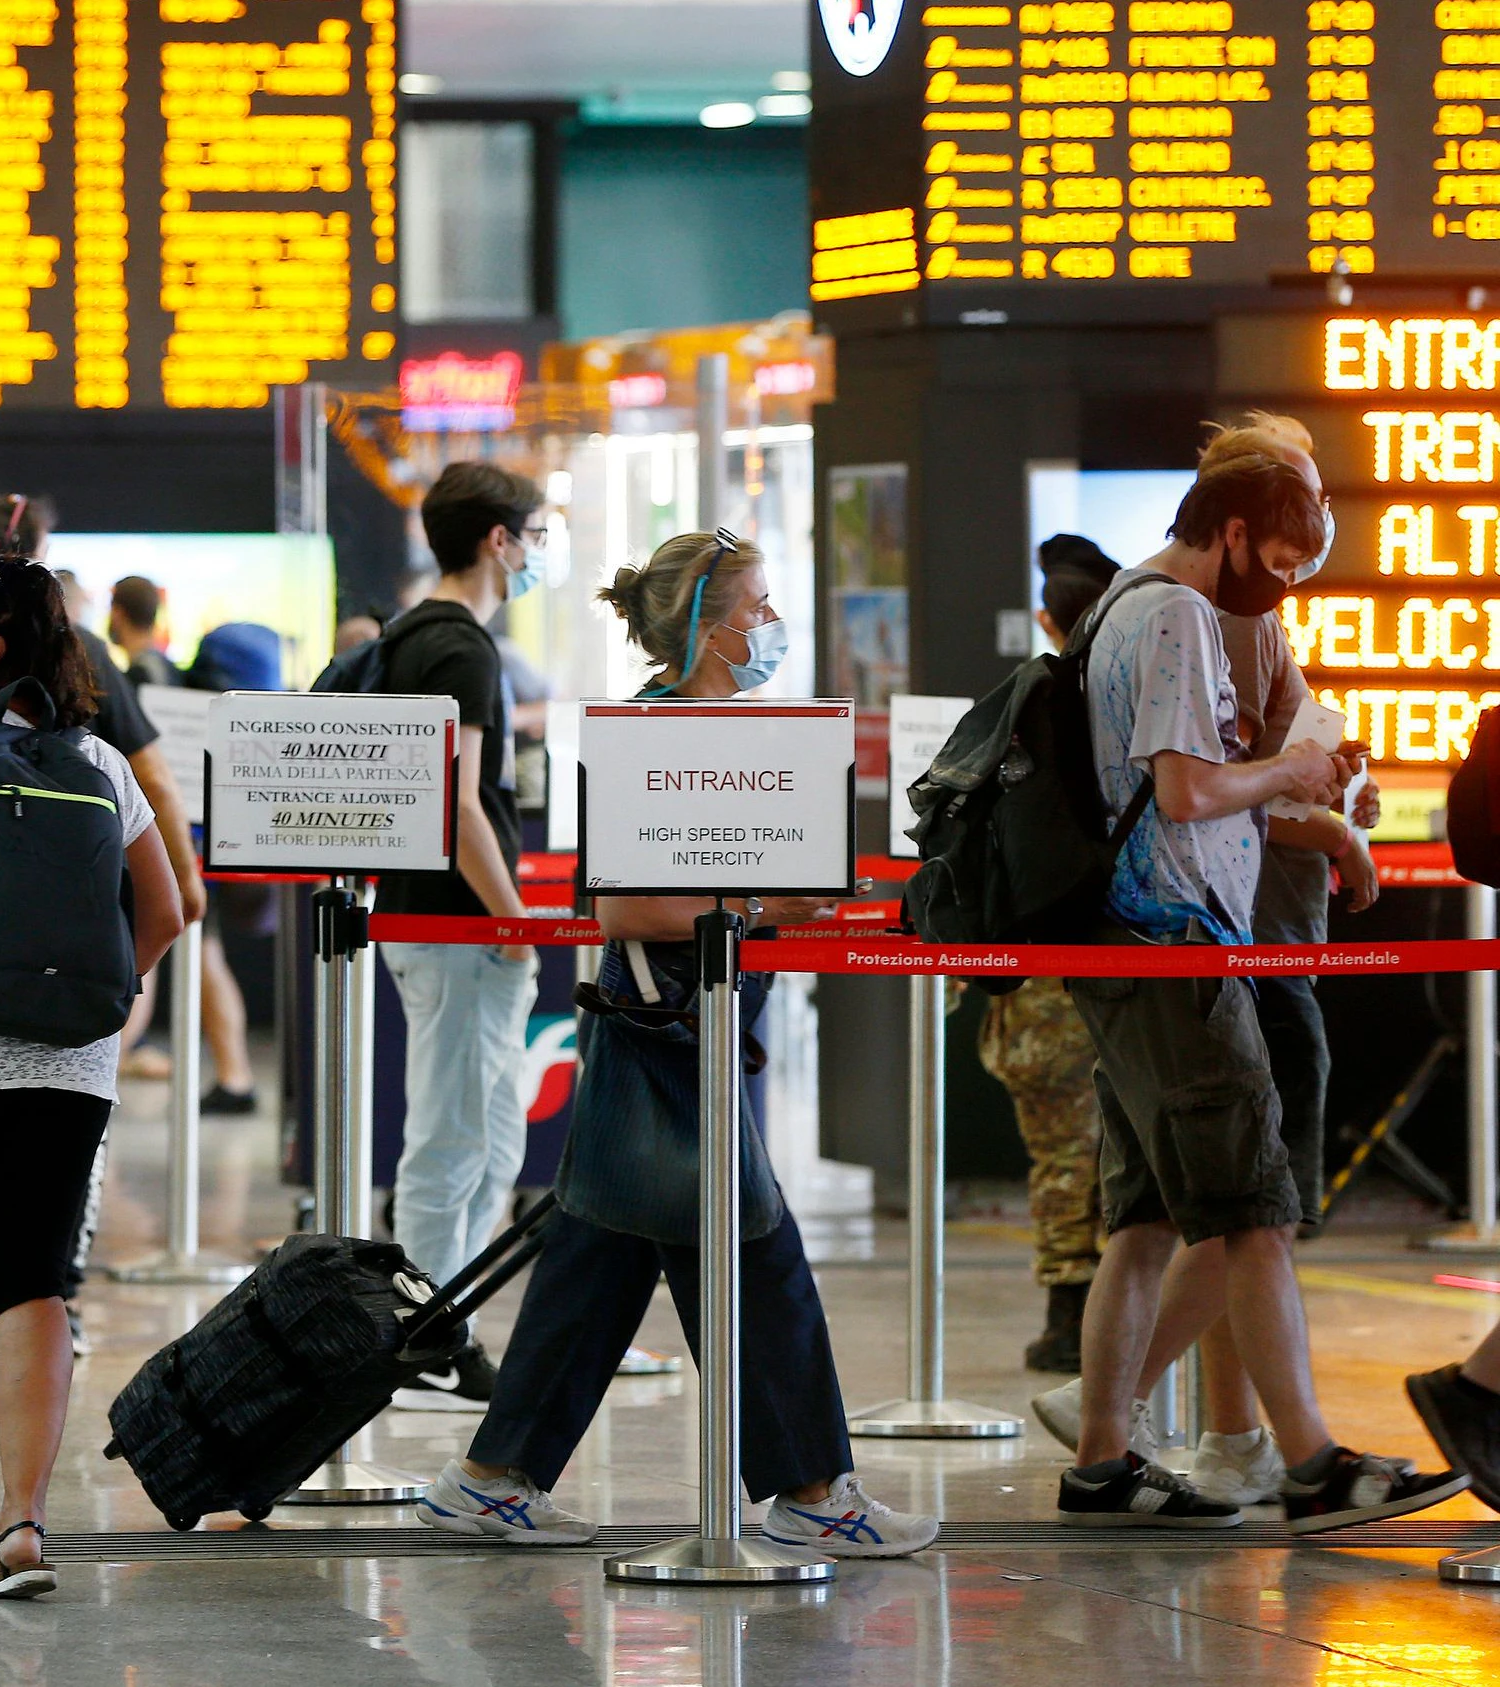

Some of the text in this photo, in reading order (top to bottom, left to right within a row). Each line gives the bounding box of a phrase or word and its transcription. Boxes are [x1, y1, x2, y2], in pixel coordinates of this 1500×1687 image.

[1378, 504, 1500, 576] ALT
[230, 721, 436, 737] INGRESSO CONSENTITO
[280, 744, 388, 760] 40 MINUTI
[232, 766, 432, 782] PRIMA DELLA PARTENZA
[647, 771, 794, 791] ENTRANCE
[247, 791, 416, 806] ENTRANCE ALLOWED
[271, 812, 395, 828] 40 MINUTES
[255, 834, 314, 846] BEFORE
[318, 835, 407, 848] DEPARTURE
[639, 828, 803, 841] HIGH SPEED TRAIN
[673, 852, 764, 865] INTERCITY
[777, 929, 841, 938] rotezione
[847, 951, 1018, 967] Protezione Aziendale
[1228, 952, 1400, 968] Protezione Aziendale
